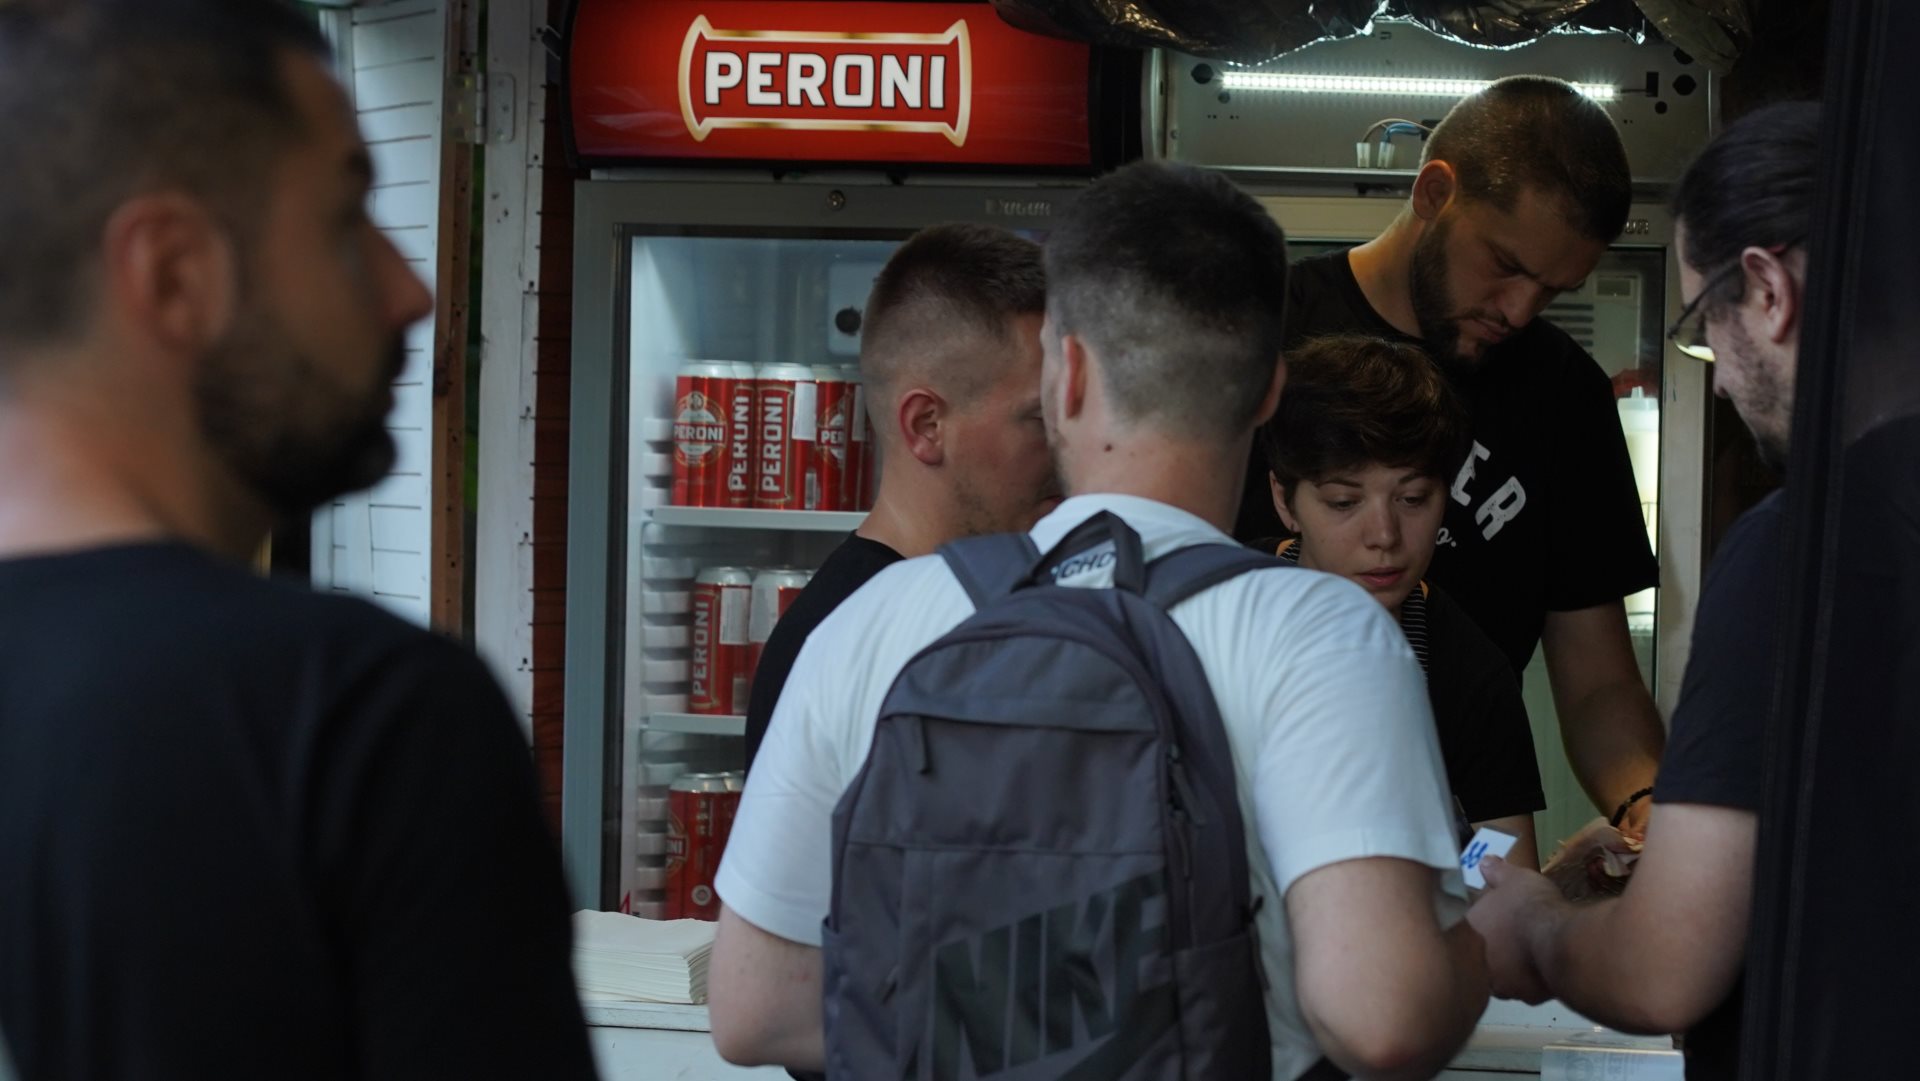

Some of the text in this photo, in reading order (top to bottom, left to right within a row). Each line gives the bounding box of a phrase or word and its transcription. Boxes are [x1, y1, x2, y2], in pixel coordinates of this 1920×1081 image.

[704, 51, 945, 110] PERONI
[674, 423, 724, 442] PERONI
[731, 395, 750, 492] PERONI
[761, 396, 784, 493] PERONI
[692, 601, 710, 697] PERONI
[930, 870, 1166, 1081] NIKE
